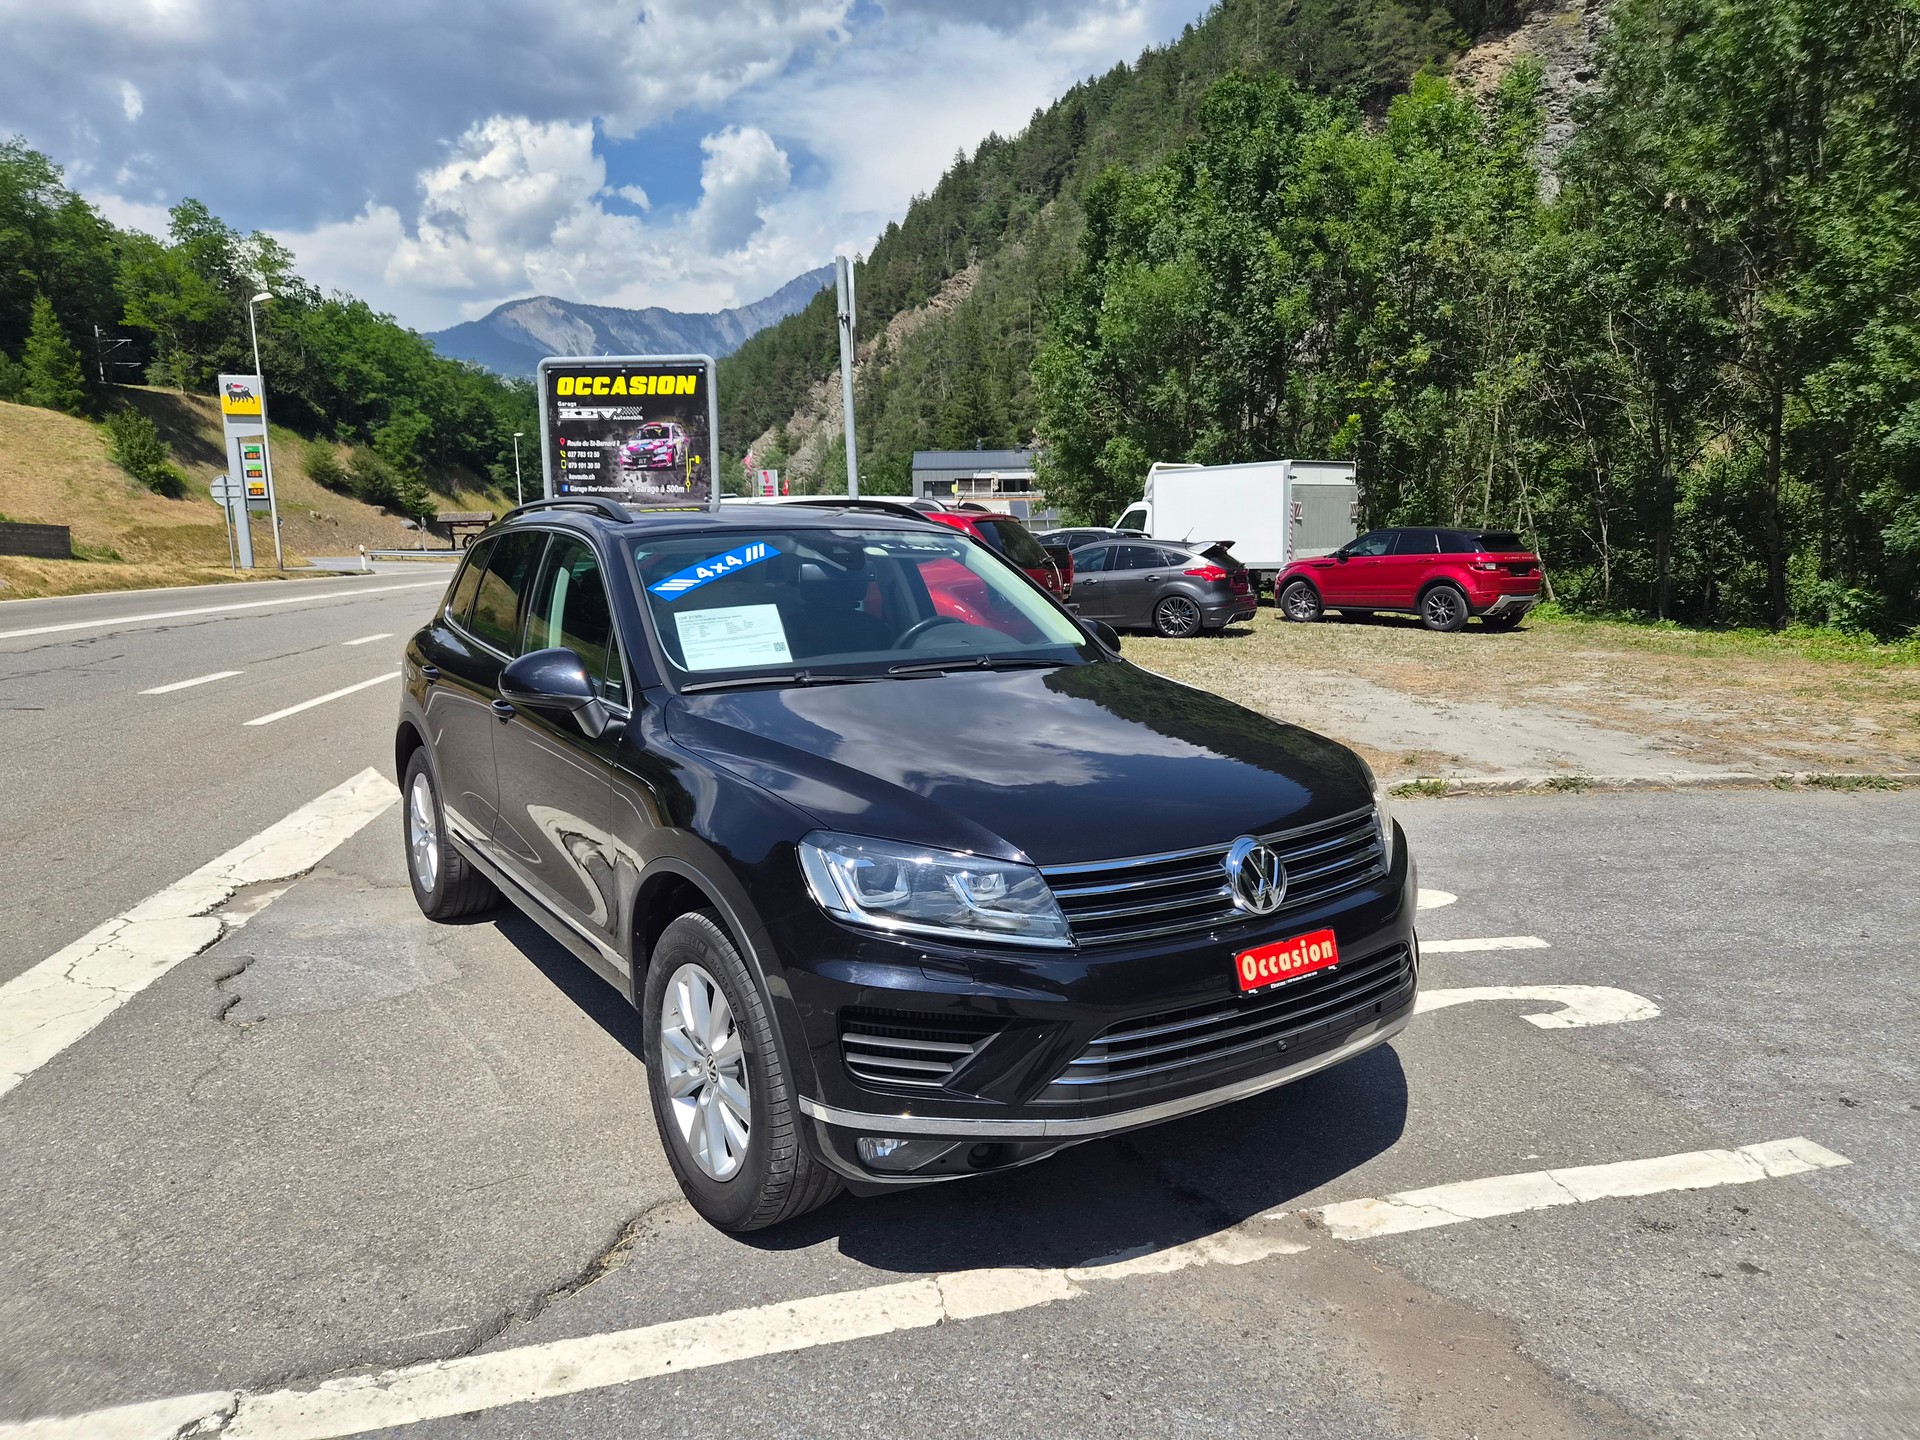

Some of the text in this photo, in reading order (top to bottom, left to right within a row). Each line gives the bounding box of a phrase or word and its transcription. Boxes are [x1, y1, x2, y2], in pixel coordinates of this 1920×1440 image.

[556, 375, 697, 396] OCCASION
[635, 484, 685, 494] Garage à 500m
[696, 555, 744, 579] 4x4
[1242, 939, 1333, 981] Occasion
